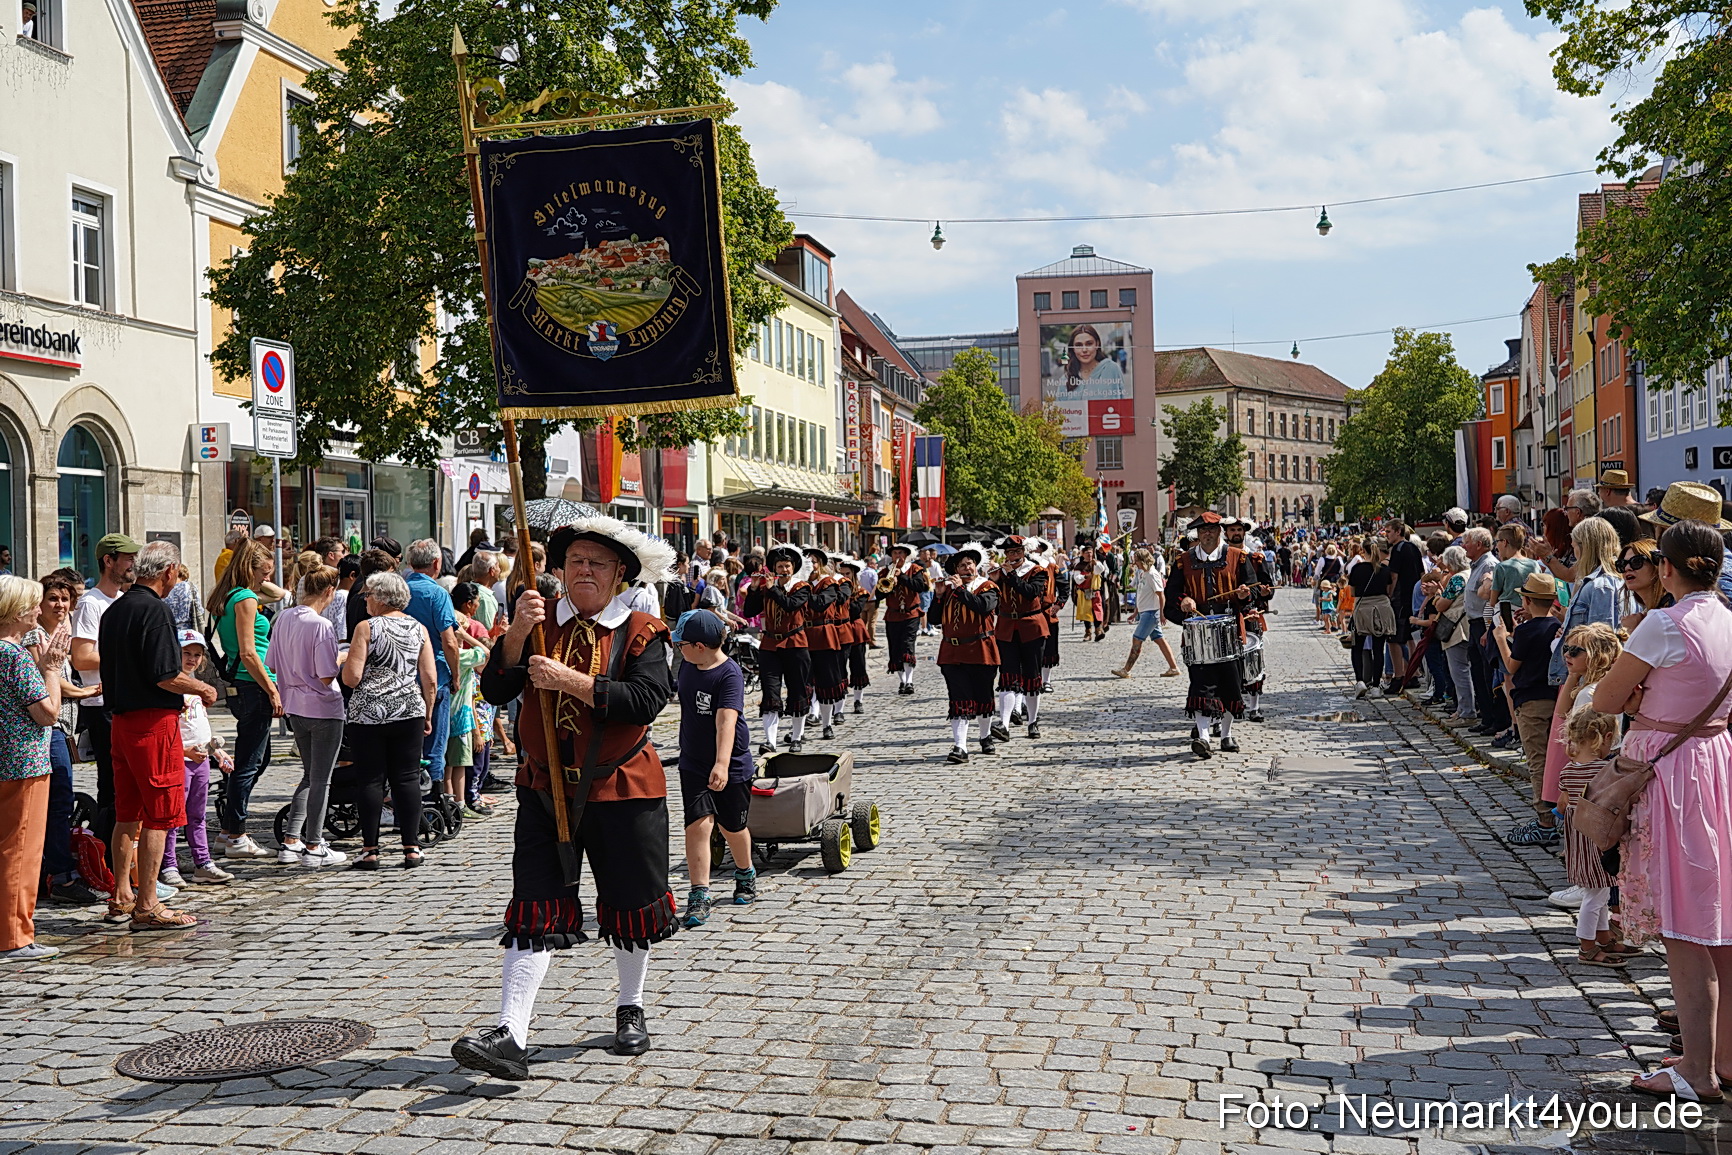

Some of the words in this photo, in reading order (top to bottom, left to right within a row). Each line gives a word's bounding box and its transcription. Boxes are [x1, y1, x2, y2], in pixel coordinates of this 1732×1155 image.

[626, 295, 686, 347] Lupburg
[531, 306, 580, 351] Markt
[1046, 378, 1067, 387] Mehr
[1082, 387, 1129, 398] Sackgasse.
[265, 394, 283, 407] ZONE
[457, 430, 480, 446] CB
[453, 447, 485, 455] Parfümerie
